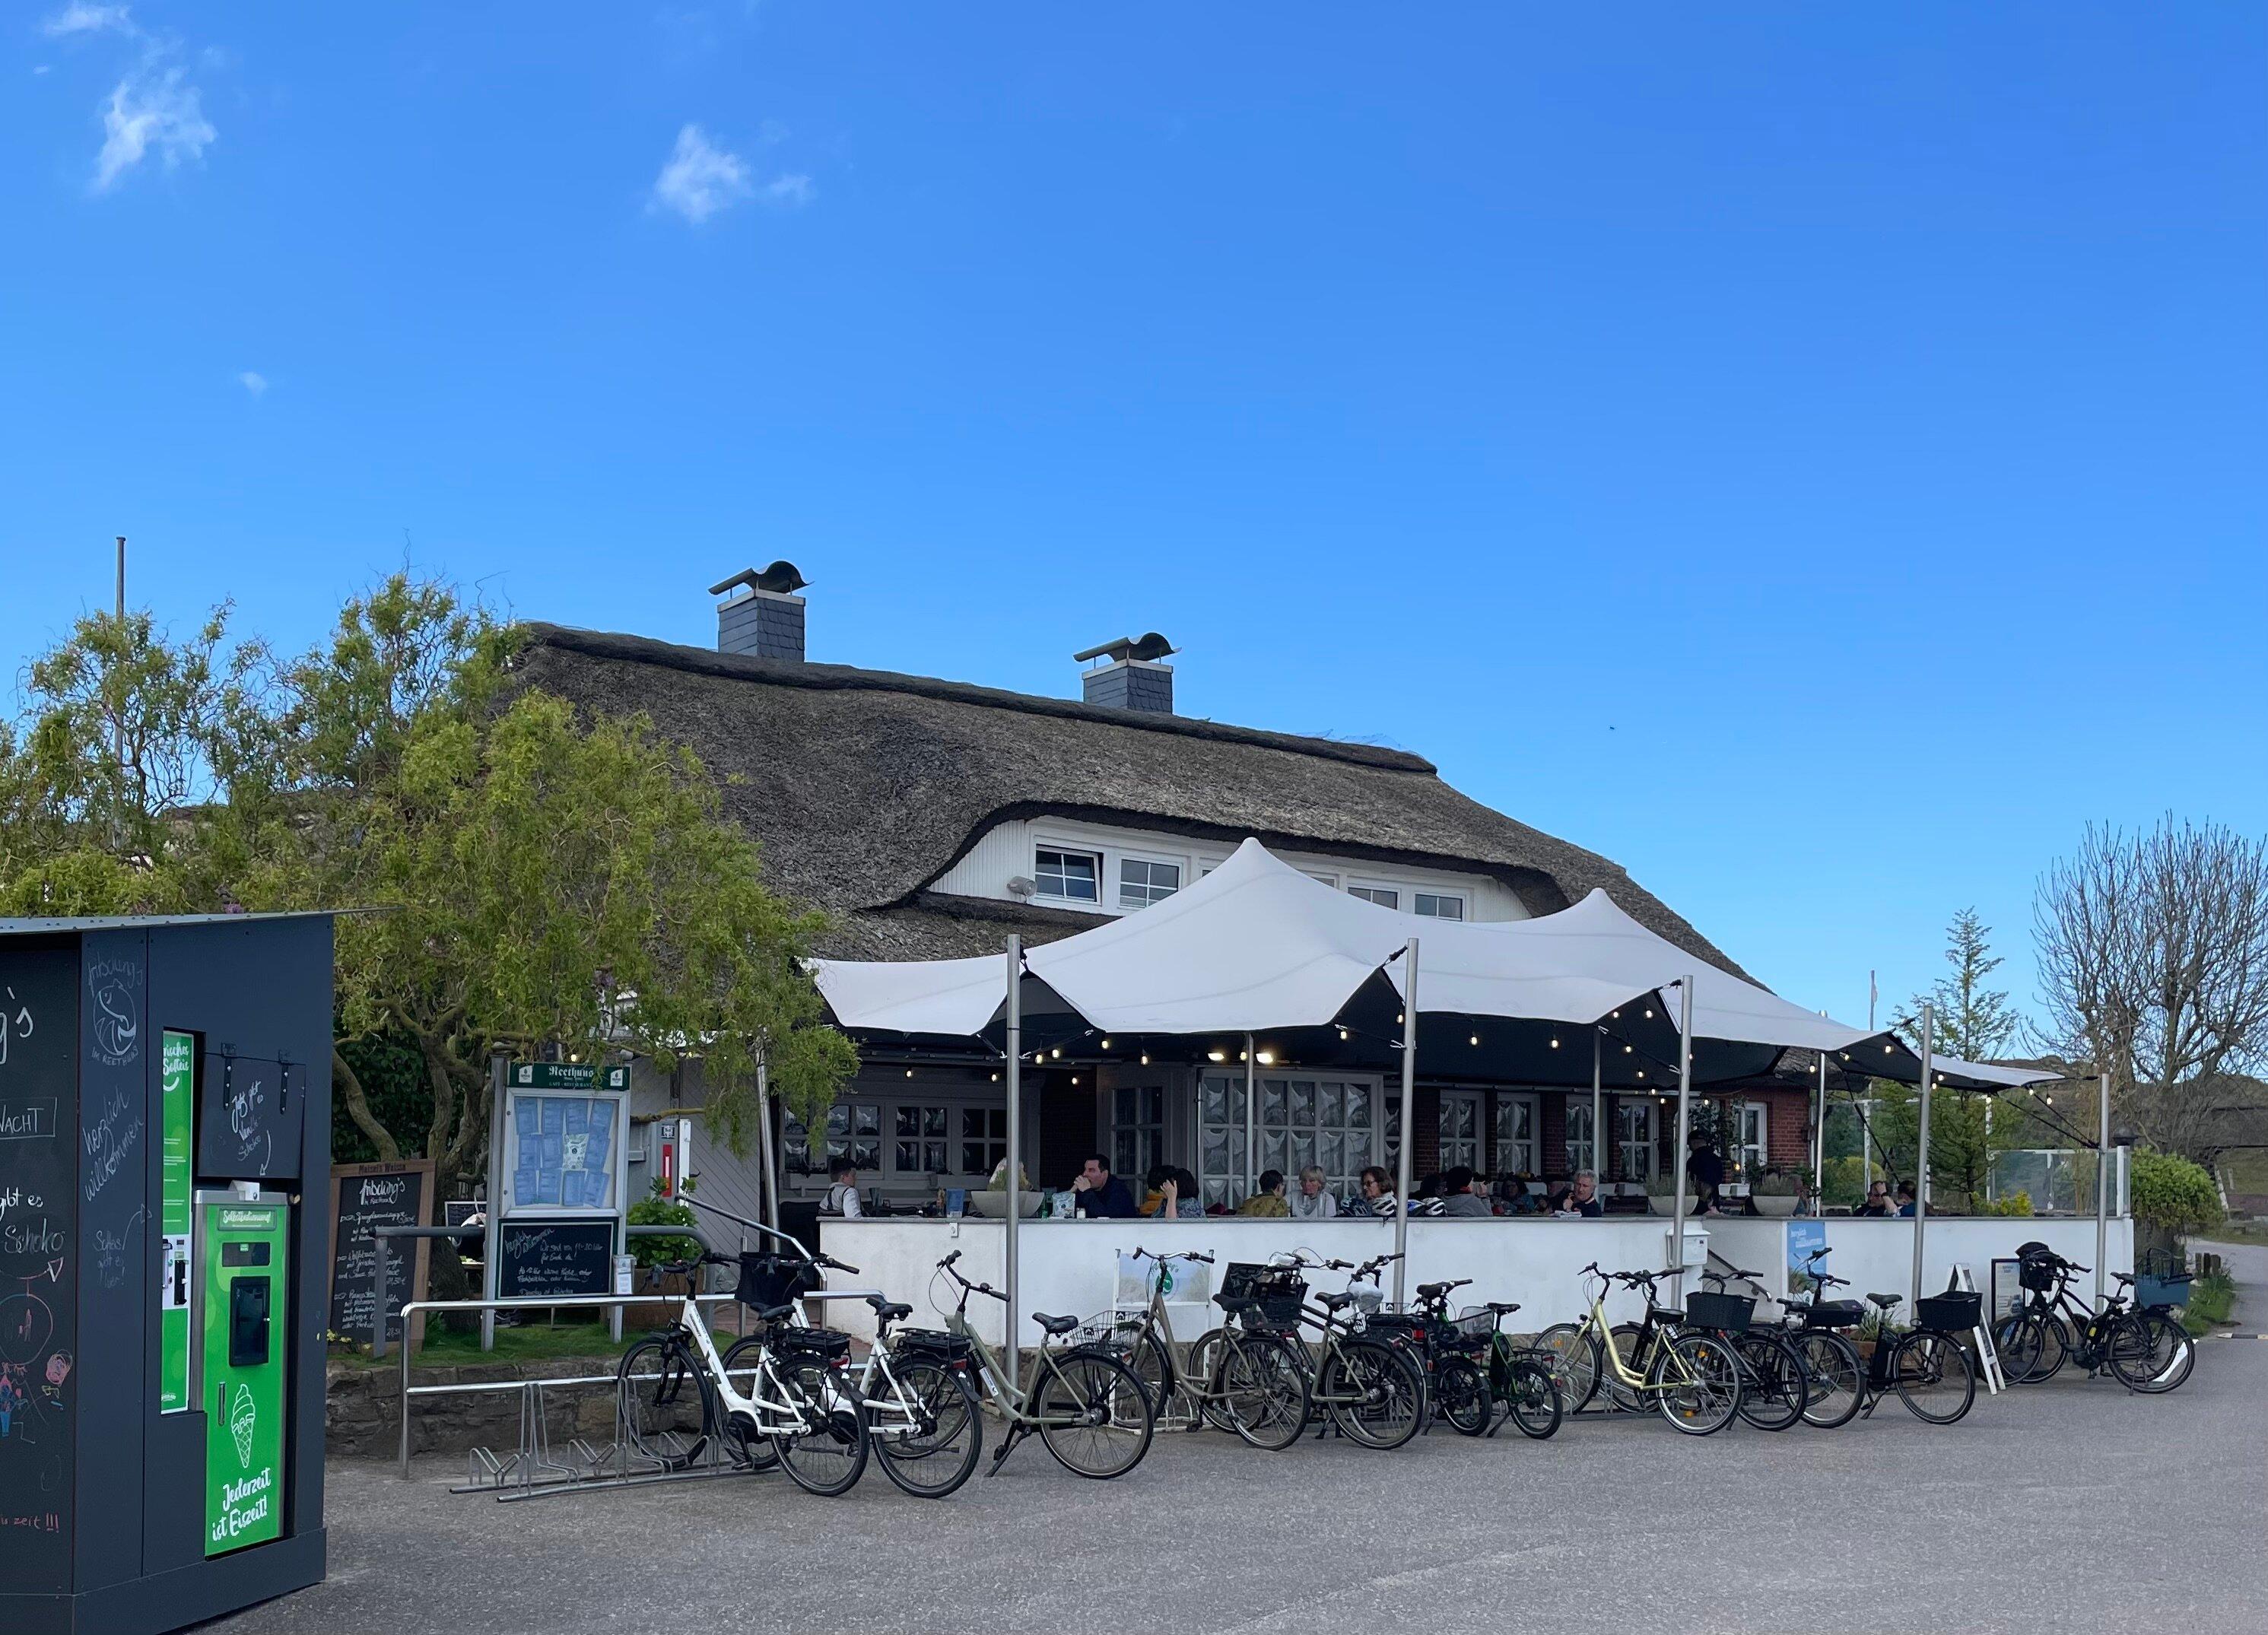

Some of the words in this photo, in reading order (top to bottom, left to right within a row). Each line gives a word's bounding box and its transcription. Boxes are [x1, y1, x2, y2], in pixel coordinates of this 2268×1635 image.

[84, 1116, 144, 1202] willkommen
[222, 1467, 272, 1512] Jederzeit
[212, 1516, 227, 1541] ist
[229, 1495, 268, 1537] Eiszeit!
